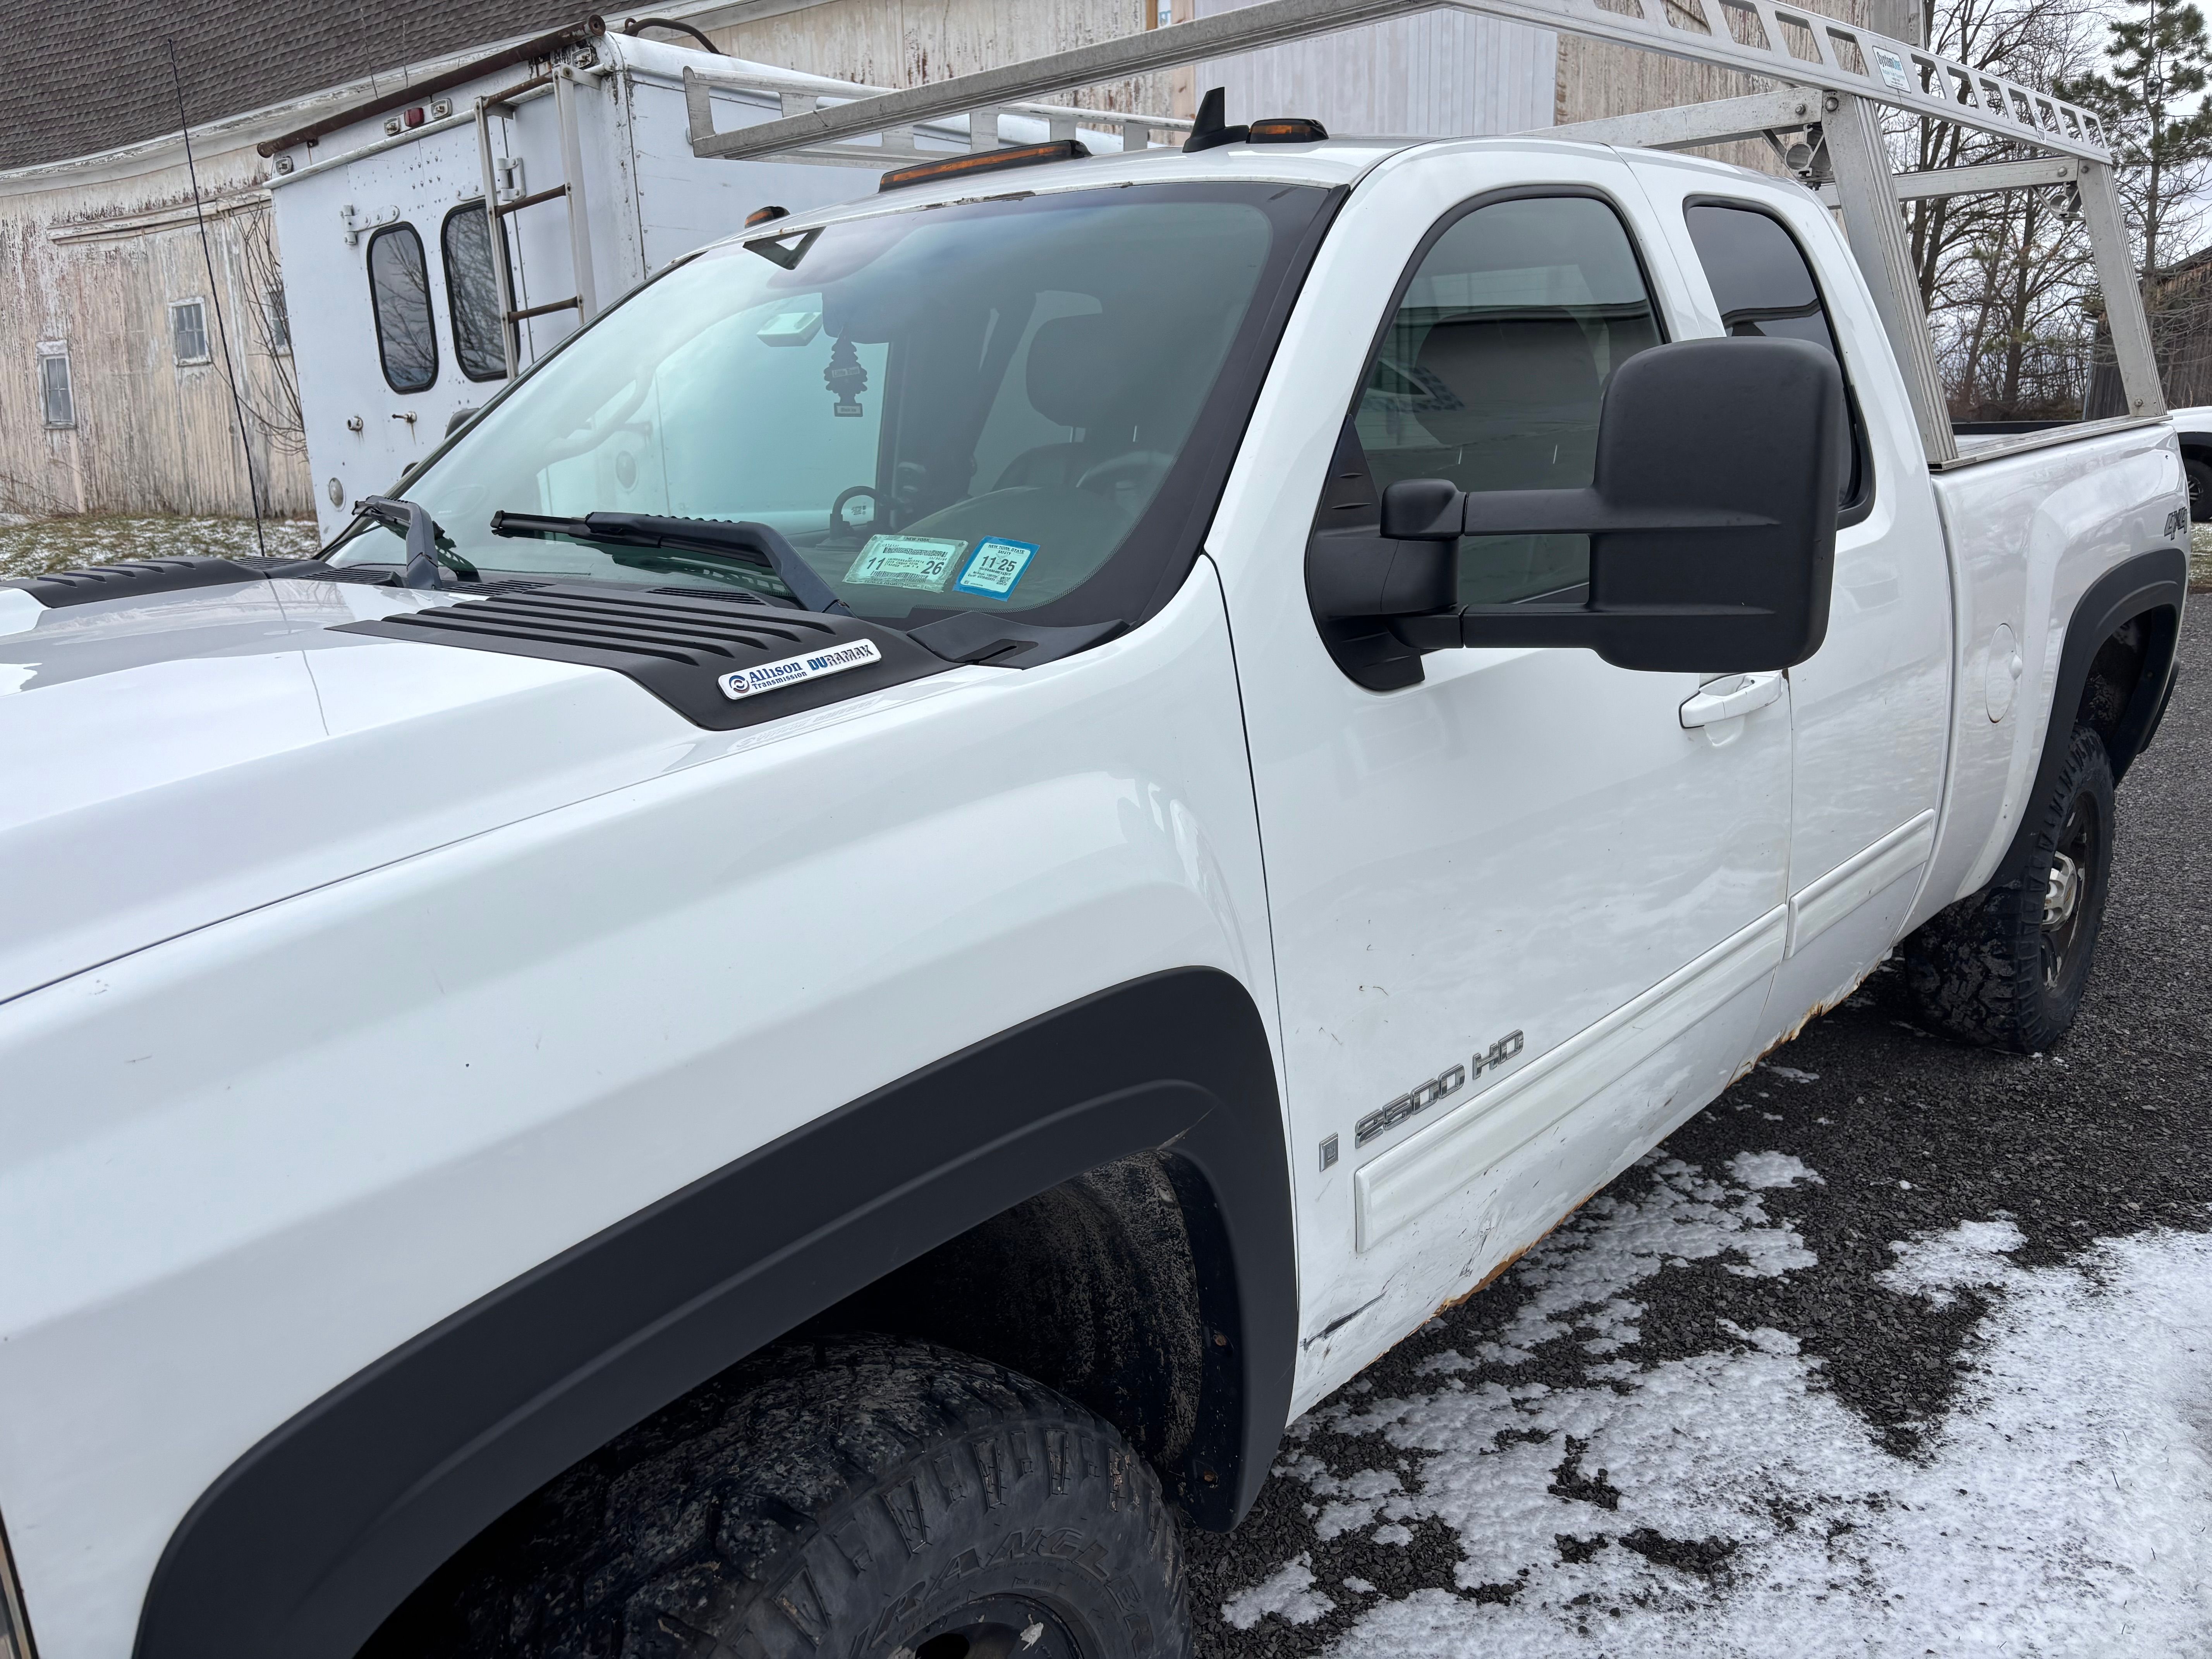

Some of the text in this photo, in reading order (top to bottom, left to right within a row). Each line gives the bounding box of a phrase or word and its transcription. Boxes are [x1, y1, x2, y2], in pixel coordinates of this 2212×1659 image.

[867, 557, 886, 570] 11
[921, 560, 945, 575] 26
[806, 645, 874, 671] DURAMAX
[750, 661, 803, 683] Allison
[752, 671, 808, 690] Transmission
[1355, 1029, 1524, 1149] 2500 HD
